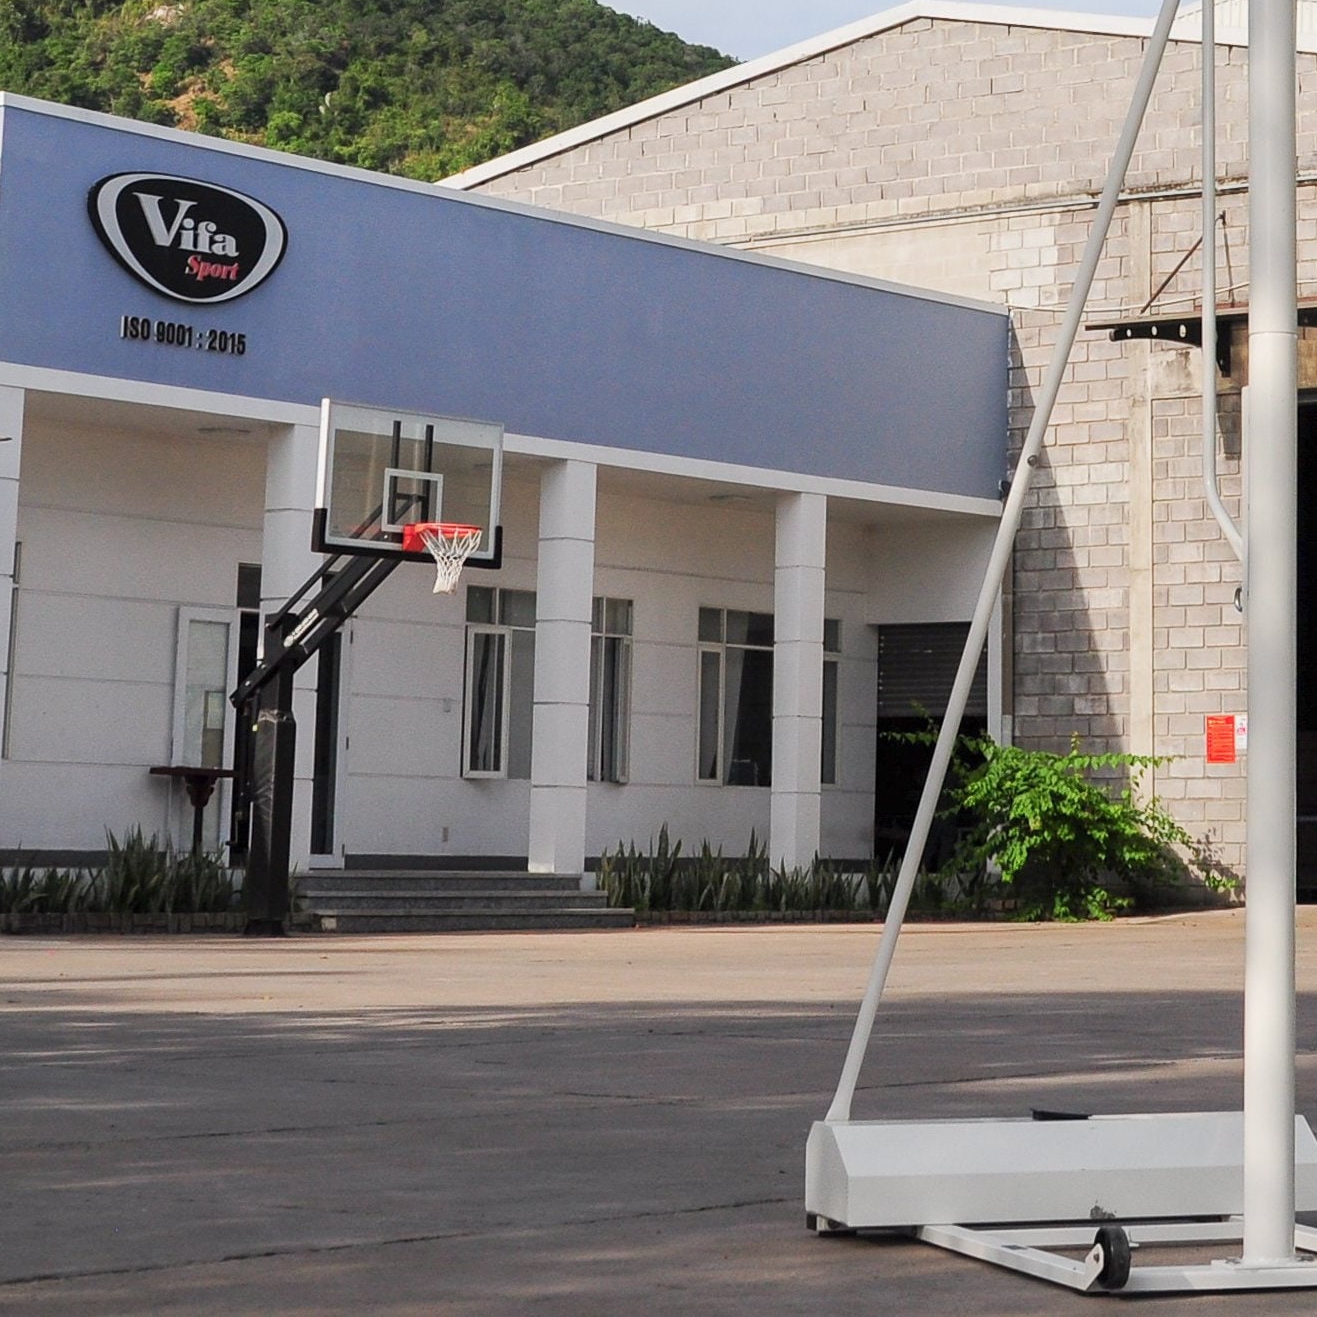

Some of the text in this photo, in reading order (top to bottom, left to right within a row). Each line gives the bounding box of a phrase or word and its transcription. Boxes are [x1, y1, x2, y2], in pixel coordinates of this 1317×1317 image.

[132, 191, 240, 257] Vifa
[185, 255, 240, 281] Sport
[120, 315, 150, 341] ISO
[154, 320, 193, 348] 9001
[206, 329, 247, 356] 2015
